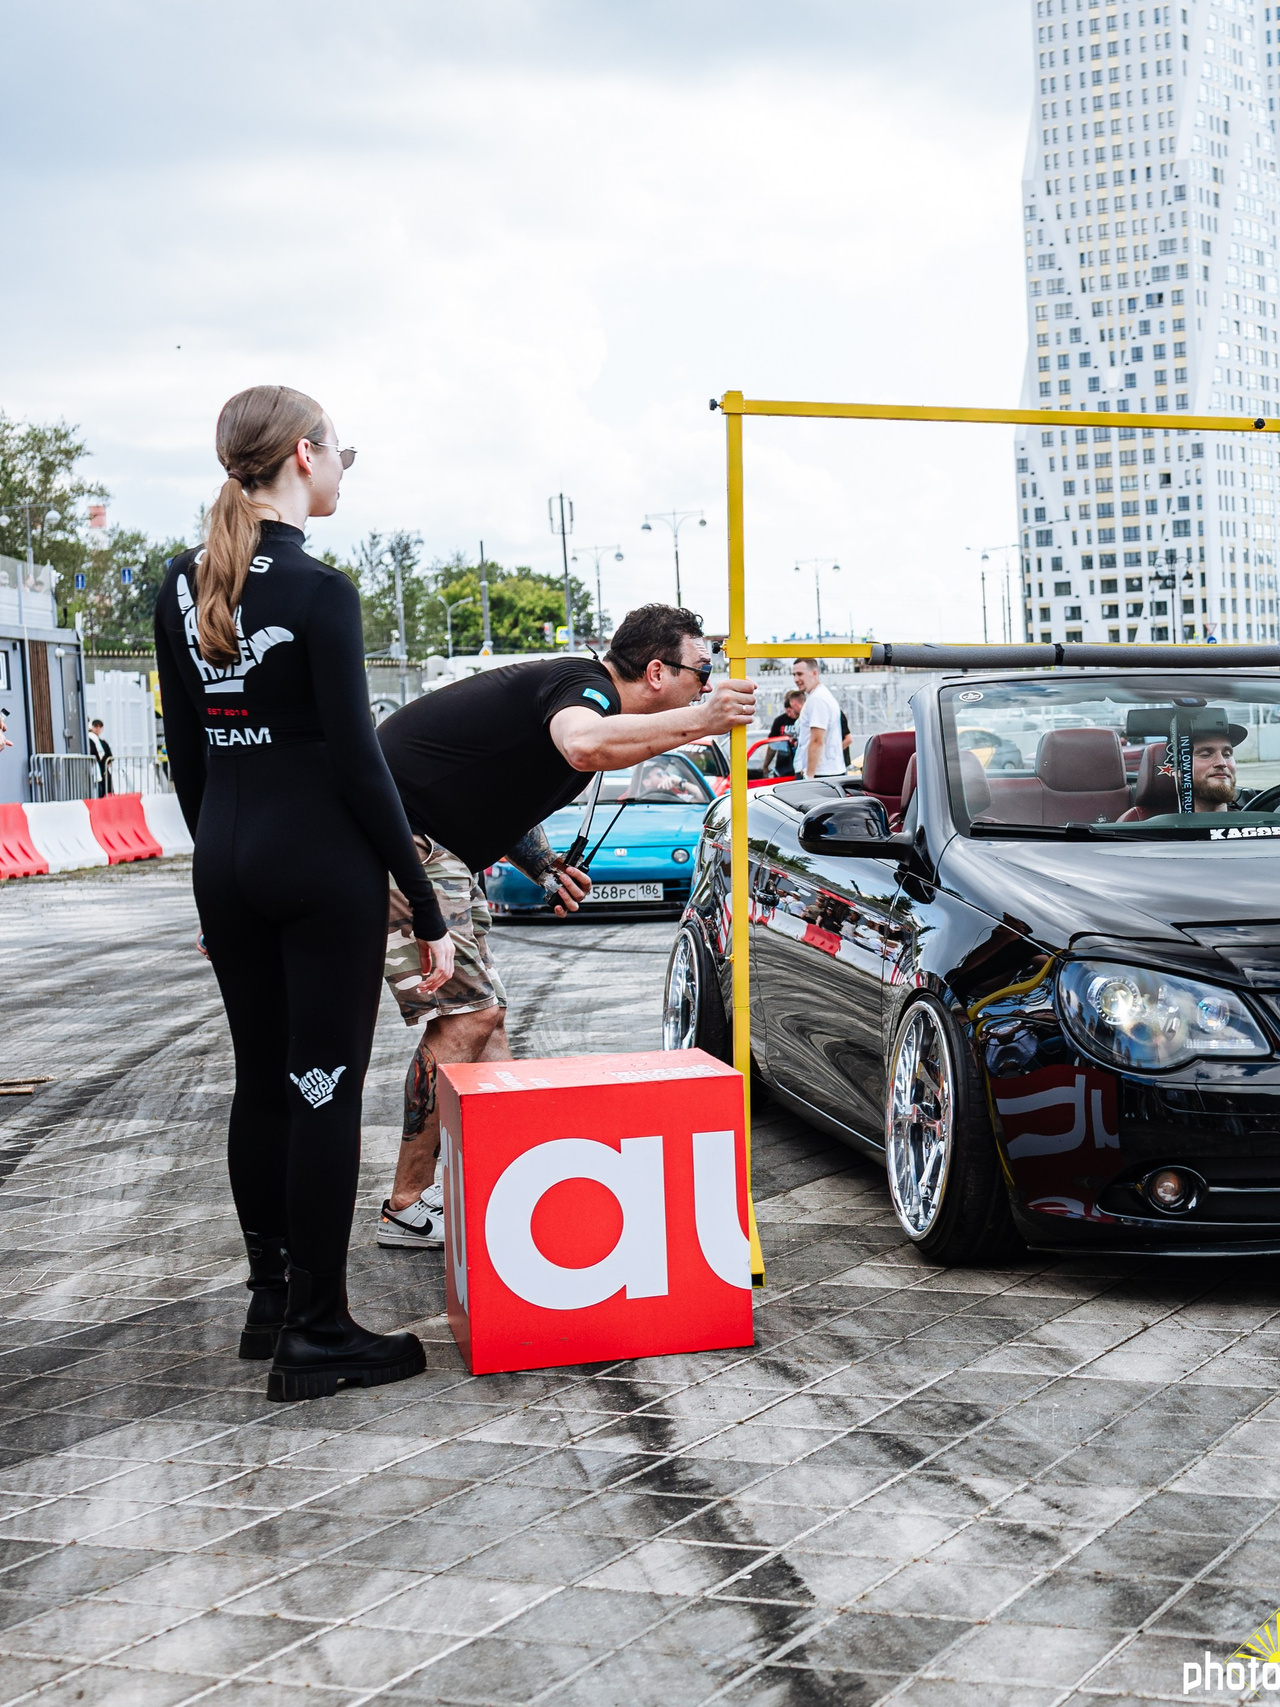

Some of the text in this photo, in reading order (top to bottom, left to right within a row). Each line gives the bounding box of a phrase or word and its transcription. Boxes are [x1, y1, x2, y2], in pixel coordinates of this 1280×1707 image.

[205, 727, 272, 746] TEAM
[1180, 735, 1190, 747] IN
[1181, 748, 1192, 771] LOW
[1183, 772, 1192, 789] WE
[592, 885, 636, 899] 568РС
[639, 885, 659, 895] 186
